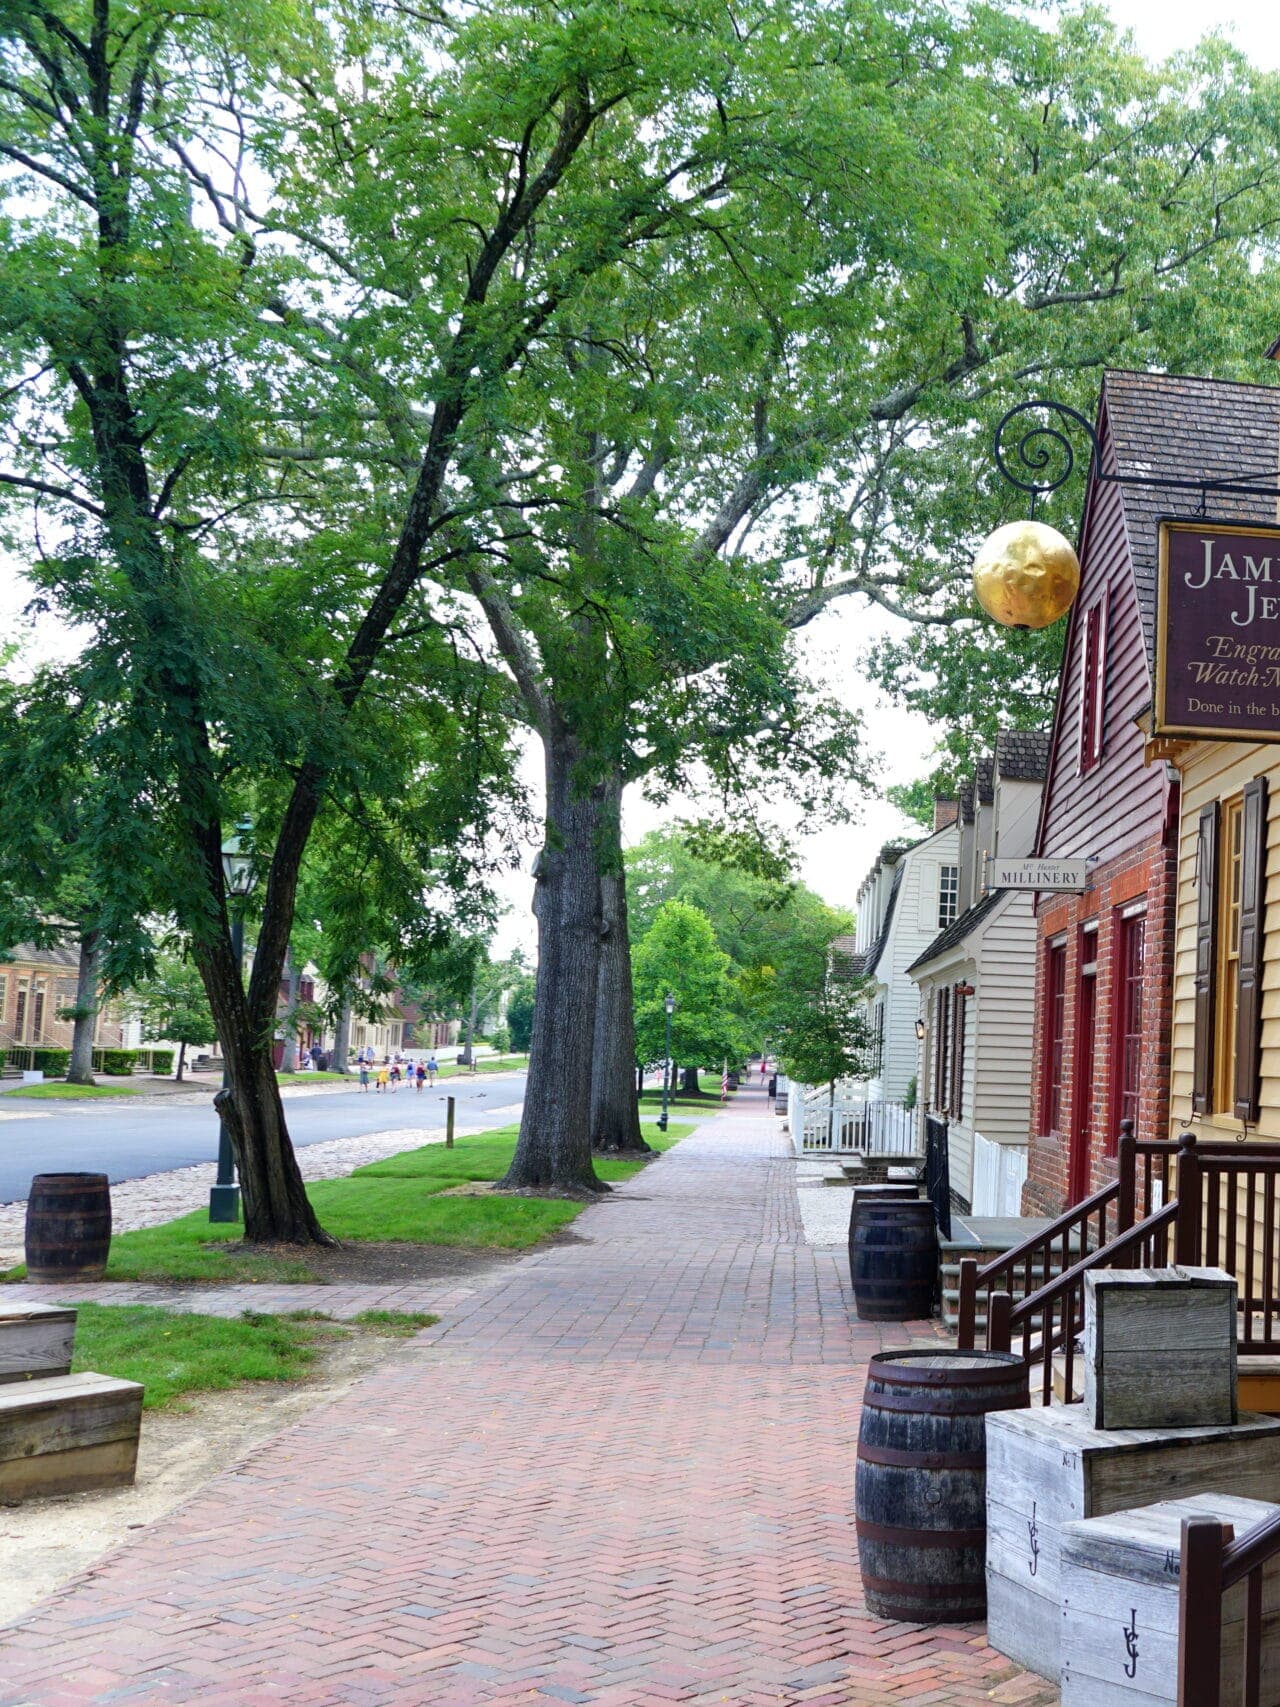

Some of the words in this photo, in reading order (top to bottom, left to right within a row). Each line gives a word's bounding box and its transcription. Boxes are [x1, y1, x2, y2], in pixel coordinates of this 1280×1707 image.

[1187, 697, 1224, 714] Done
[1228, 700, 1241, 714] in
[1246, 702, 1267, 716] the
[1001, 871, 1079, 884] MILLINERY
